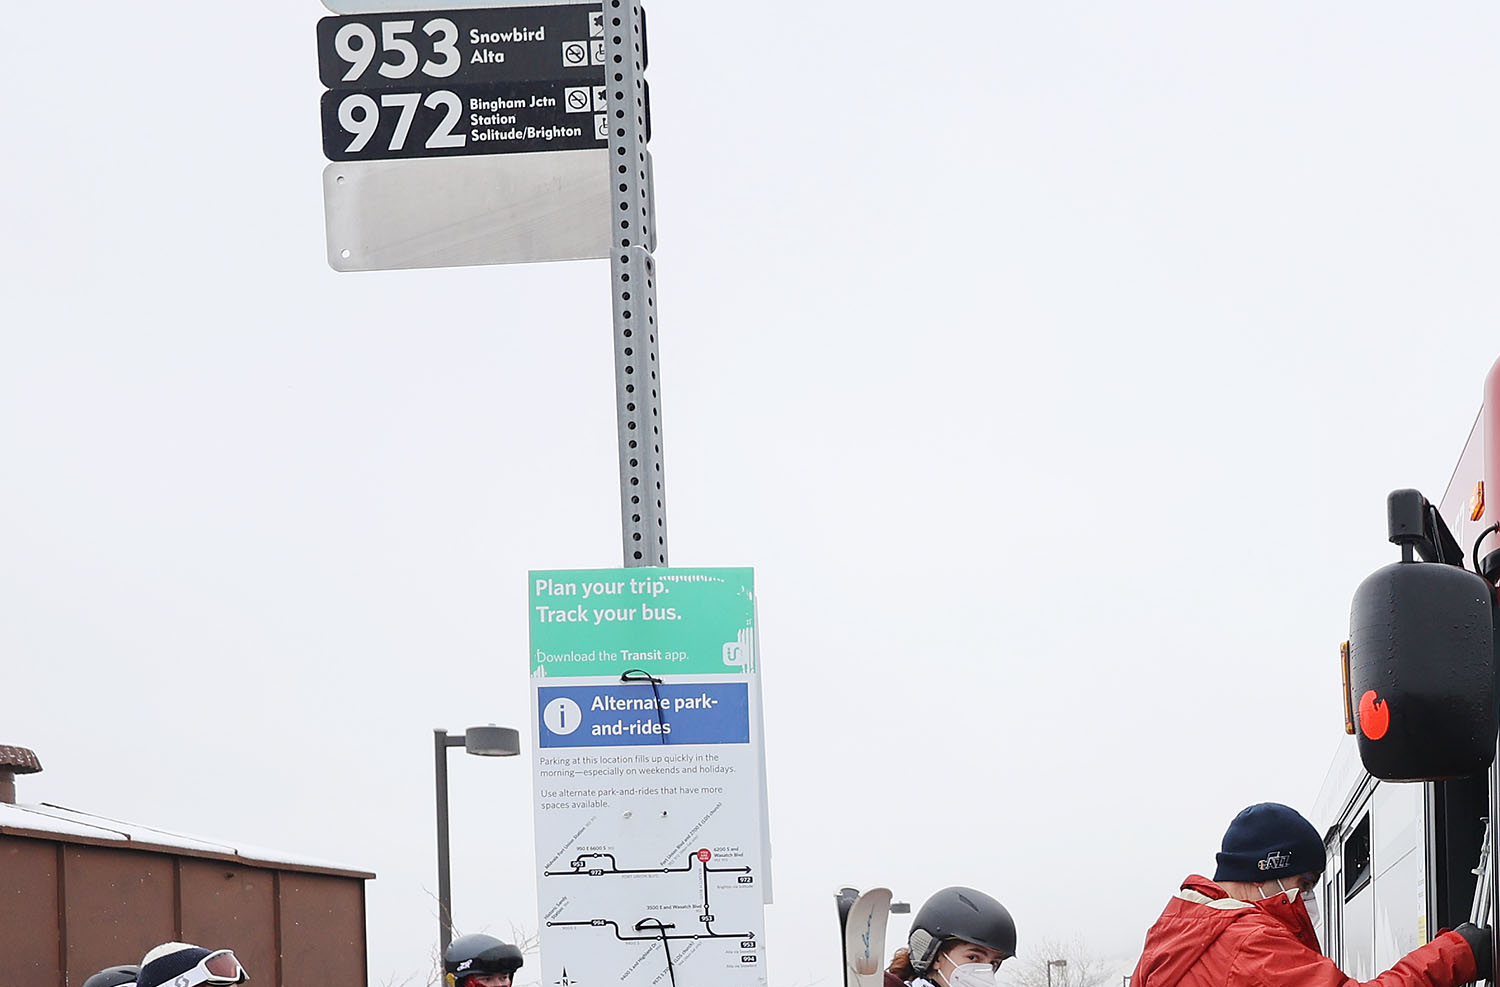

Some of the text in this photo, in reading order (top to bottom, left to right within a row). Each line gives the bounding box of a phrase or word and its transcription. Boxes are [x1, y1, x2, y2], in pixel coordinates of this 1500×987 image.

[469, 26, 545, 44] Snowbird
[335, 18, 461, 82] 953
[470, 50, 505, 64] Alta
[469, 96, 556, 112] Bingham Jctn
[338, 90, 467, 153] 972
[470, 113, 516, 126] Station
[470, 125, 582, 142] Solitude/Brighton
[535, 578, 670, 599] Plan your trip.
[536, 603, 682, 625] Track your bus.
[536, 649, 689, 664] Download the Transit app.
[591, 693, 718, 713] Alternate park-
[591, 720, 671, 736] and-rides
[540, 753, 719, 767] Parking at this location fills up quickly in the
[639, 766, 679, 774] weekends
[681, 765, 698, 774] and
[699, 764, 736, 776] holidays.
[541, 789, 556, 798] Use
[559, 788, 595, 797] alternate
[597, 787, 659, 798] park-and-rides
[660, 786, 677, 795] that
[679, 785, 699, 795] have
[541, 800, 610, 811] spaces available.
